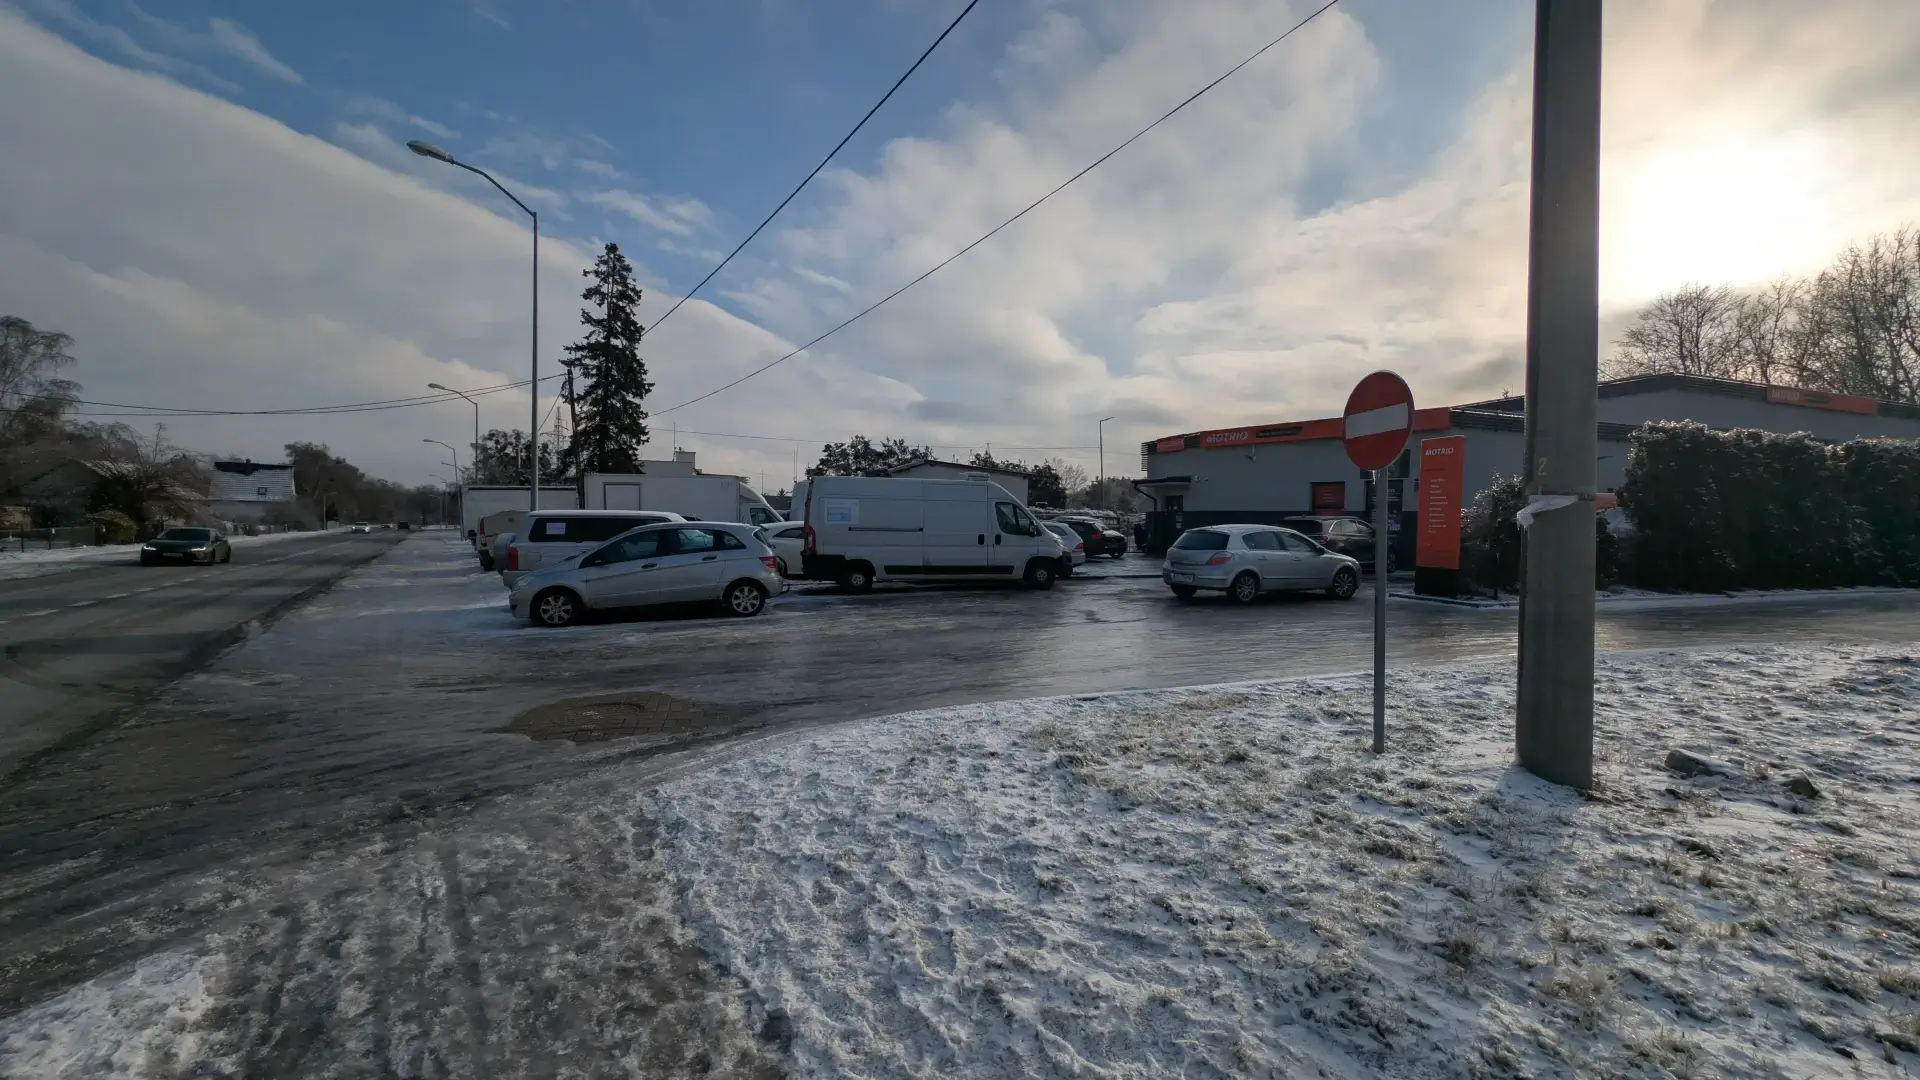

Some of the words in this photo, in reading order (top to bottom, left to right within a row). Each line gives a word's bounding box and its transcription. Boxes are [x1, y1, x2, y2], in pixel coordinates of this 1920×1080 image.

[1206, 431, 1249, 443] MOTRIO
[1425, 447, 1454, 456] MOTRIO
[1538, 457, 1548, 475] 2
